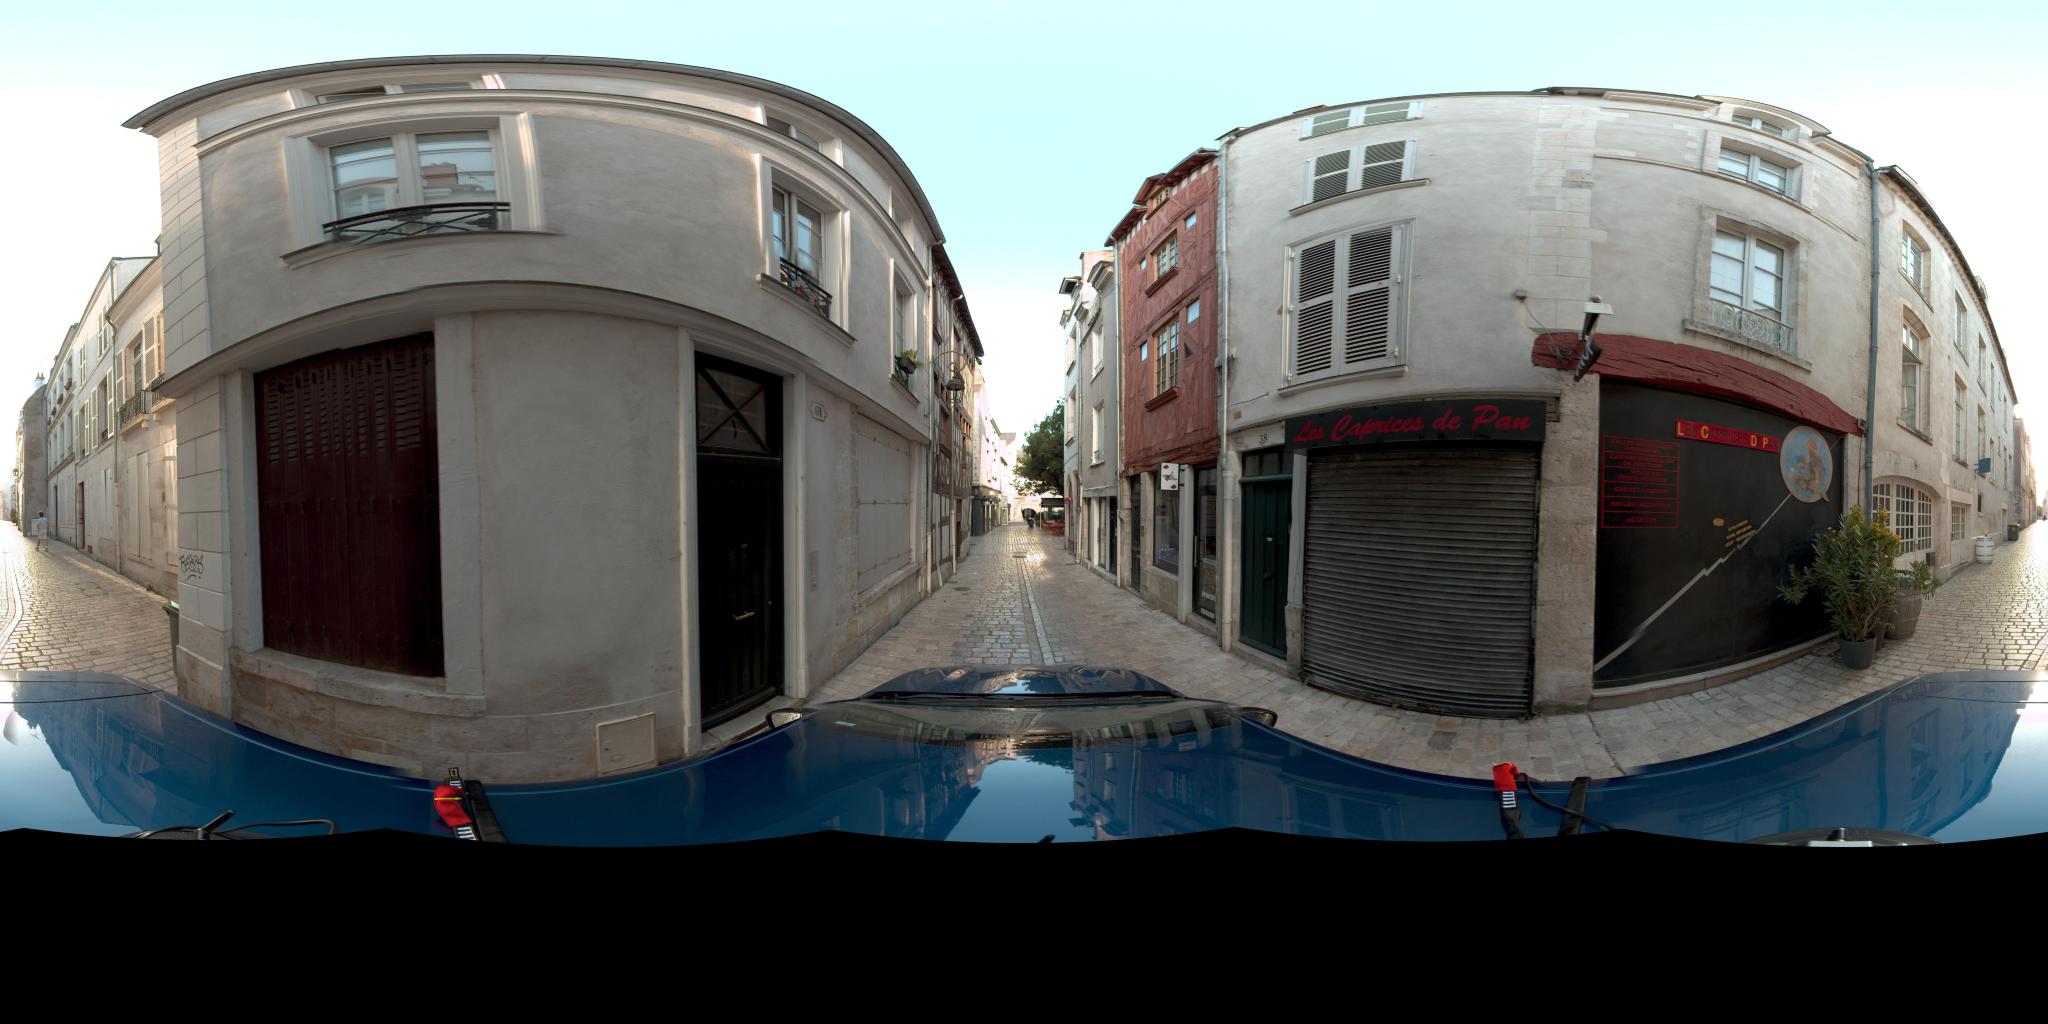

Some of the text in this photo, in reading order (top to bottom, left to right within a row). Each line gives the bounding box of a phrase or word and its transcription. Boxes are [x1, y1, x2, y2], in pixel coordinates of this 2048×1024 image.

[1294, 403, 1532, 442] Les Caprices de Pan
